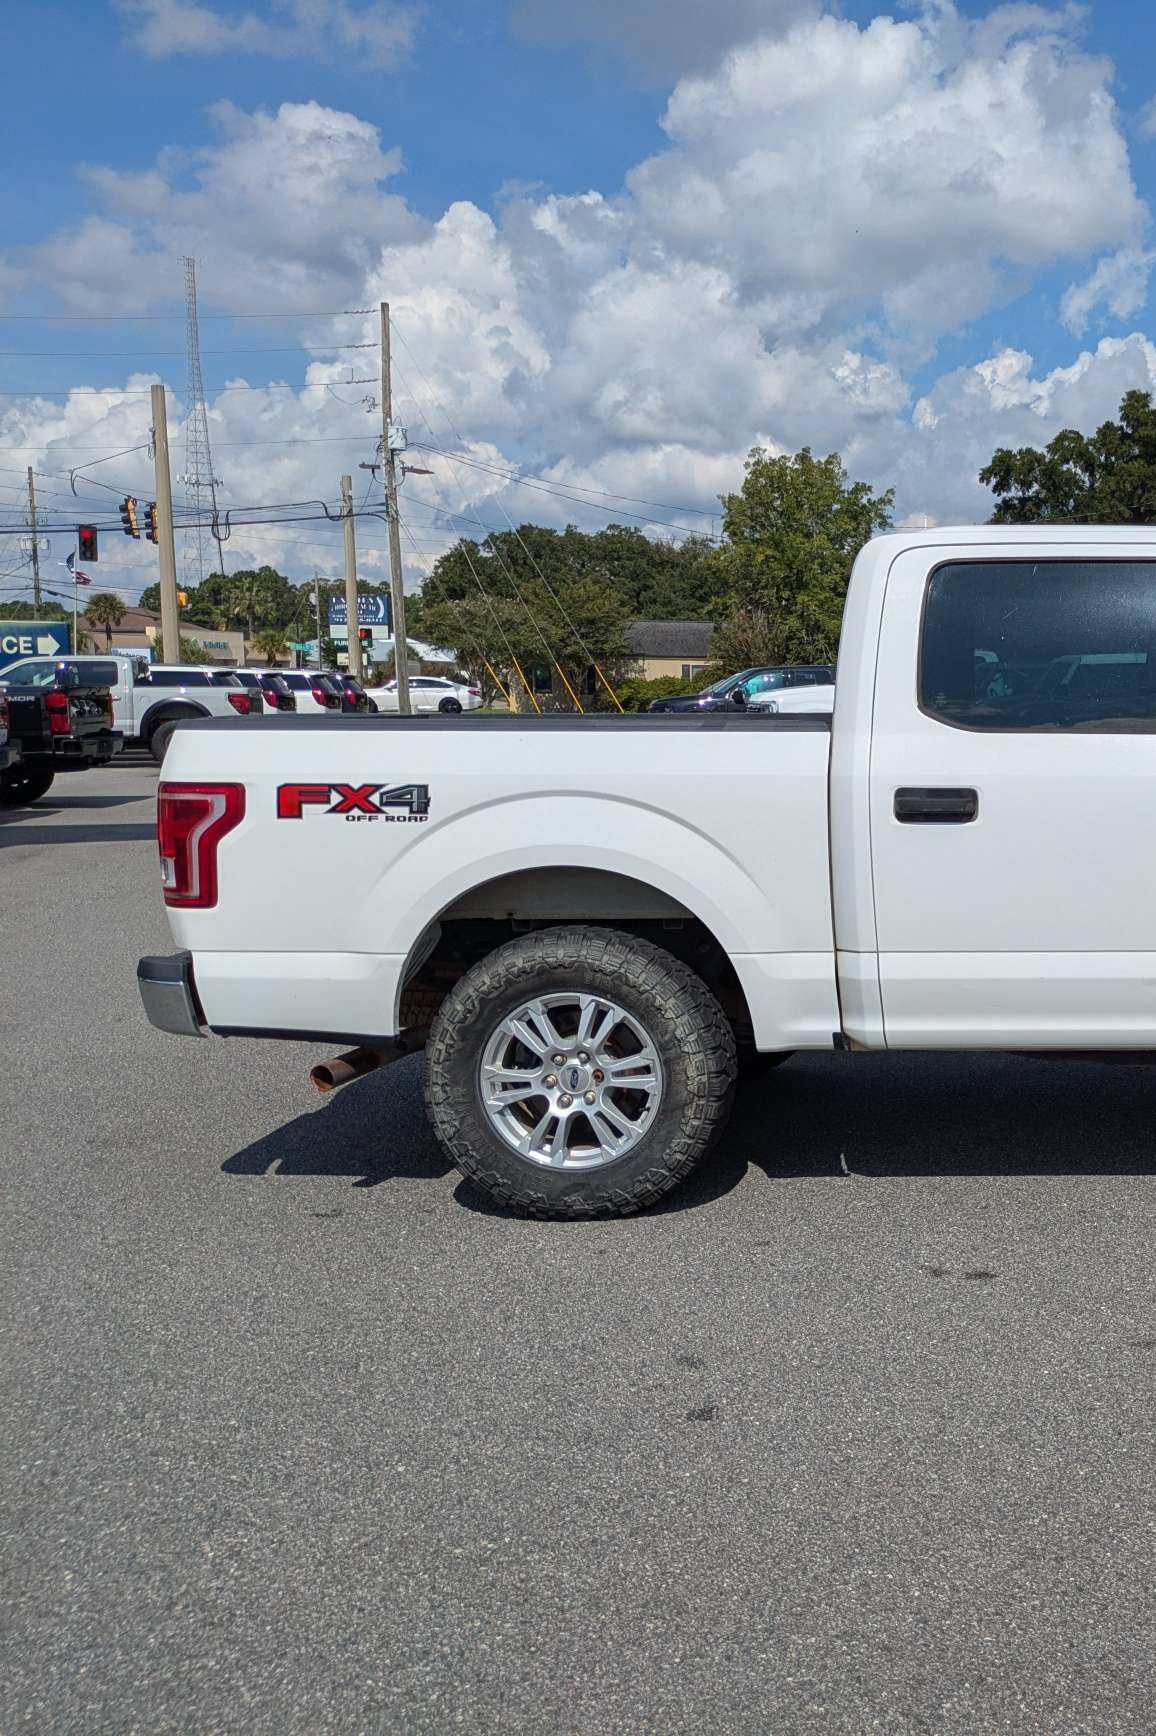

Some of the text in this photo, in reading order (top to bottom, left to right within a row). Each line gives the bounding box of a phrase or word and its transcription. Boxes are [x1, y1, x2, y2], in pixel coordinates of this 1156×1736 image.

[0, 636, 33, 654] CE
[277, 783, 431, 819] FX4
[345, 815, 379, 823] OFF
